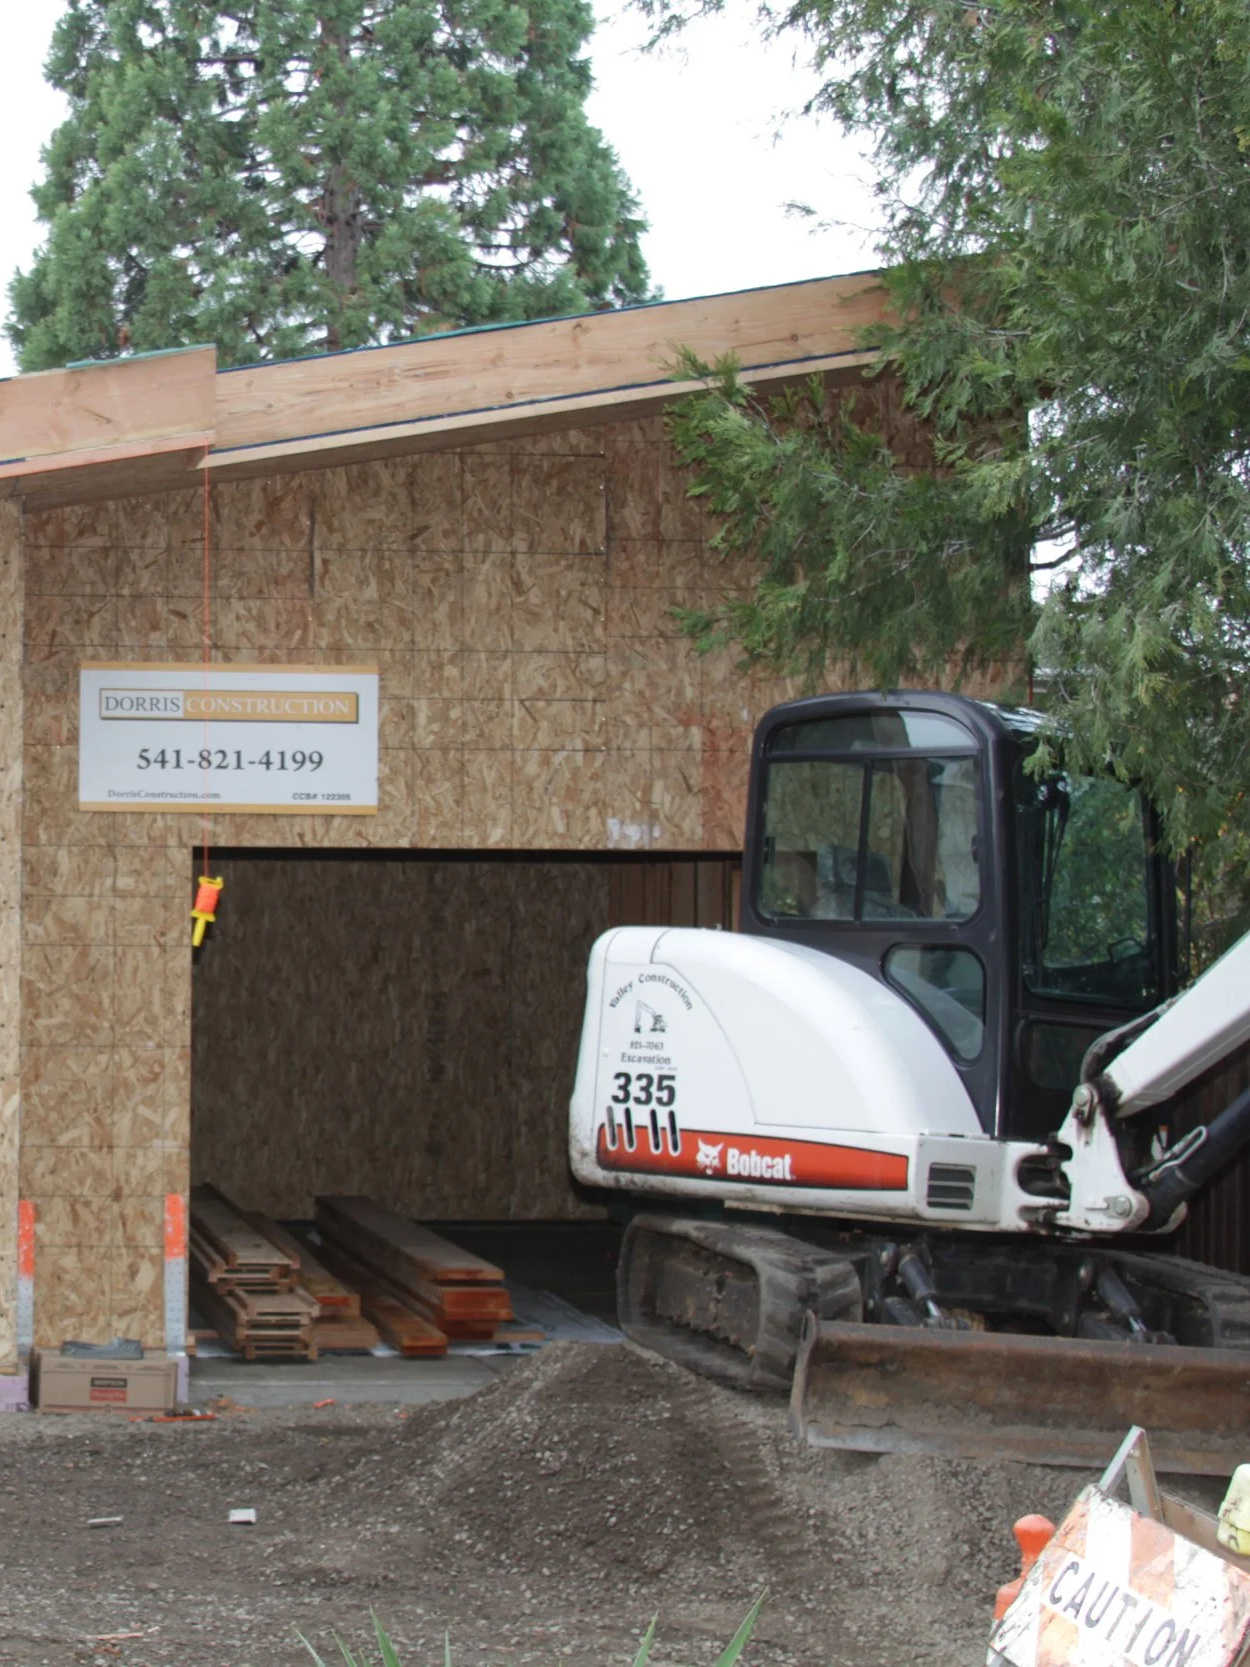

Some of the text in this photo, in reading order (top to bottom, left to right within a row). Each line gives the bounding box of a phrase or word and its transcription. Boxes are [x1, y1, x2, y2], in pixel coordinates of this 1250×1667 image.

[104, 695, 349, 716] DORRIS CONSTRUCTION
[136, 748, 324, 772] 541-821-4199
[107, 789, 222, 800] DorrisConstruction.com
[292, 792, 318, 801] CCB#
[609, 973, 693, 1010] Valley Construction
[620, 1052, 671, 1065] Excavation
[611, 1072, 676, 1107] 335
[727, 1148, 792, 1180] Bobcat
[1049, 1561, 1202, 1667] CAUTION
